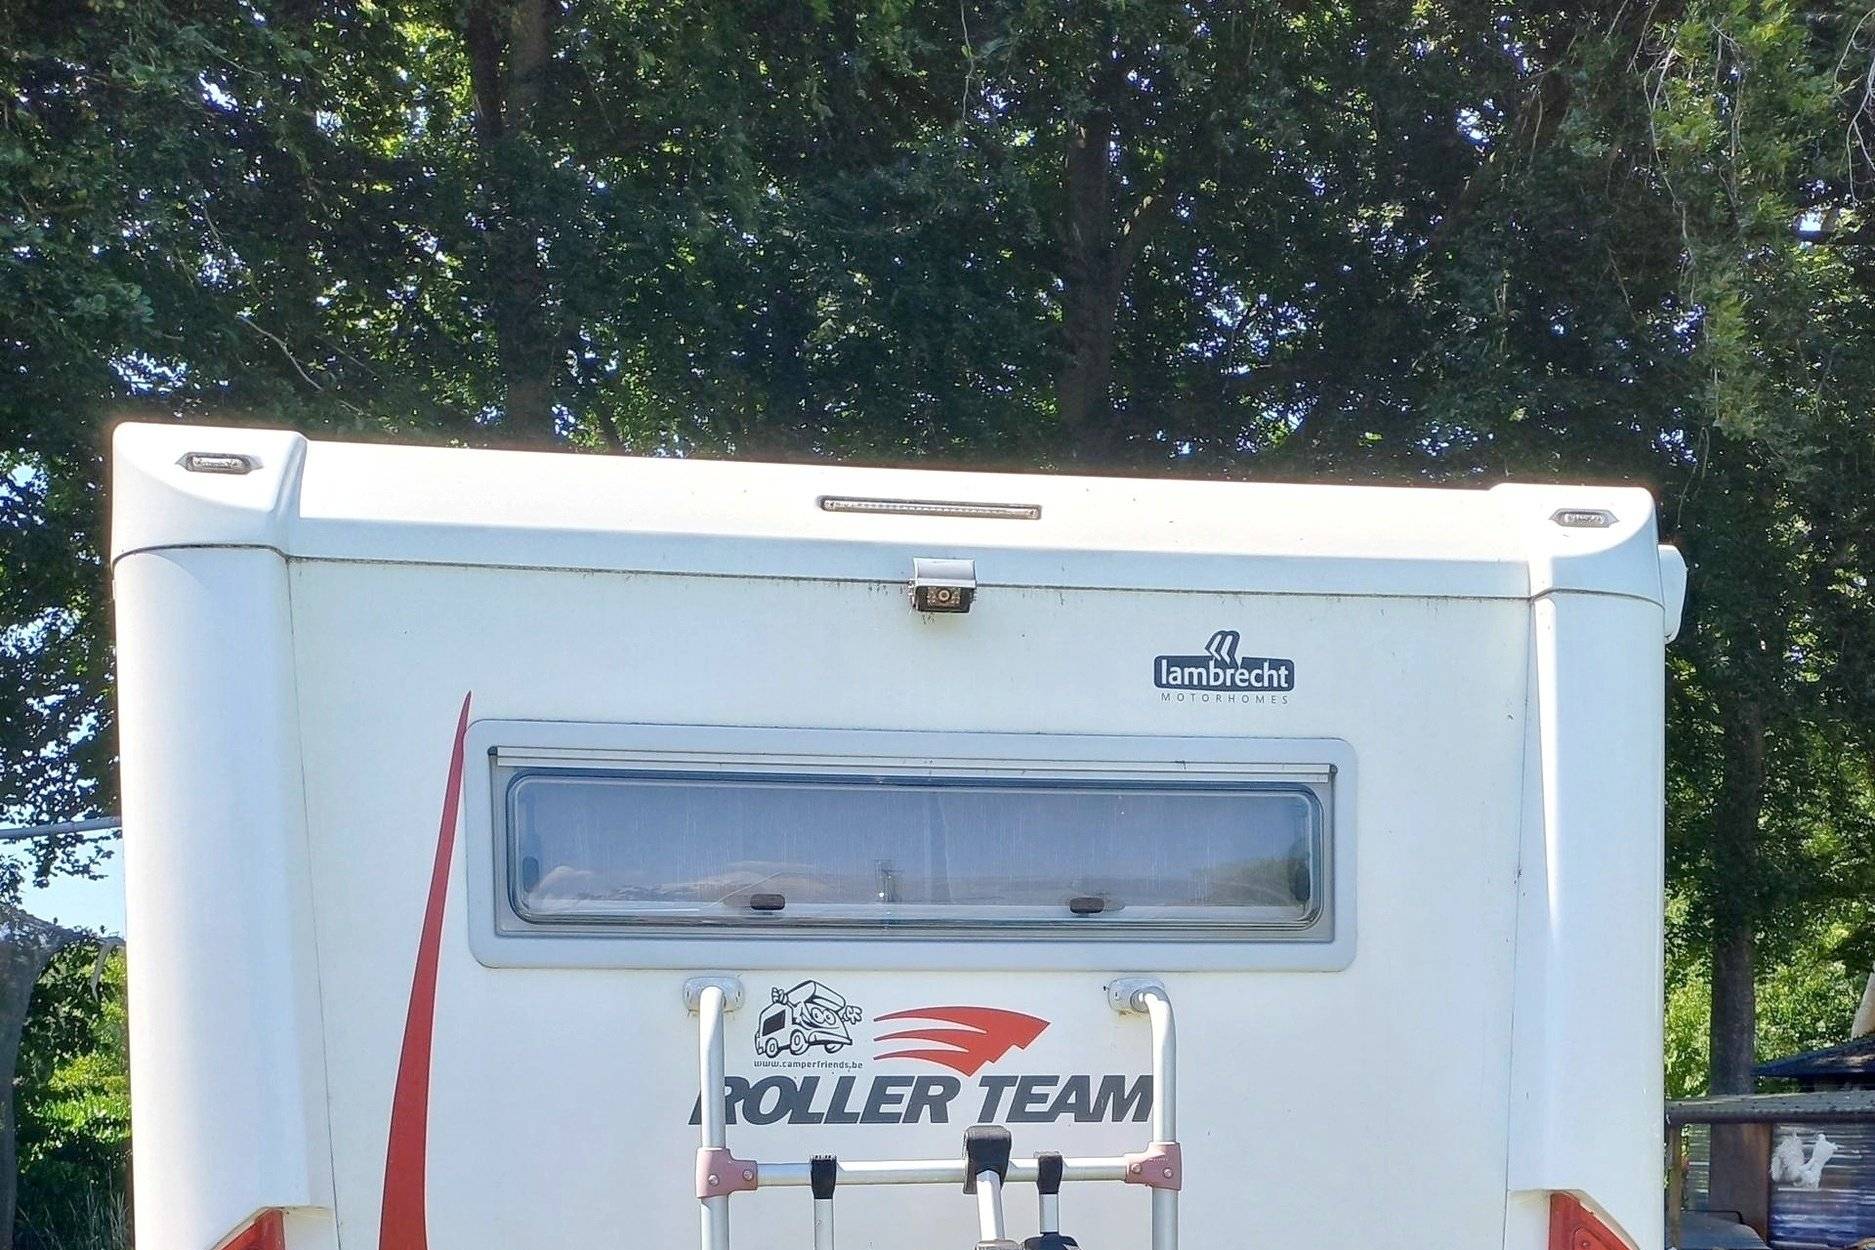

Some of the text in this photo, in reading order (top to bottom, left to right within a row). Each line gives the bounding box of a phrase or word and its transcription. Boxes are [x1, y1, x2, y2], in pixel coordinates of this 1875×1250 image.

[1160, 658, 1290, 689] lambrecht
[1160, 691, 1289, 705] MOTORHOMES
[753, 1060, 864, 1071] www.camperfriends.be
[688, 1073, 1154, 1126] ROLLER TEAM
